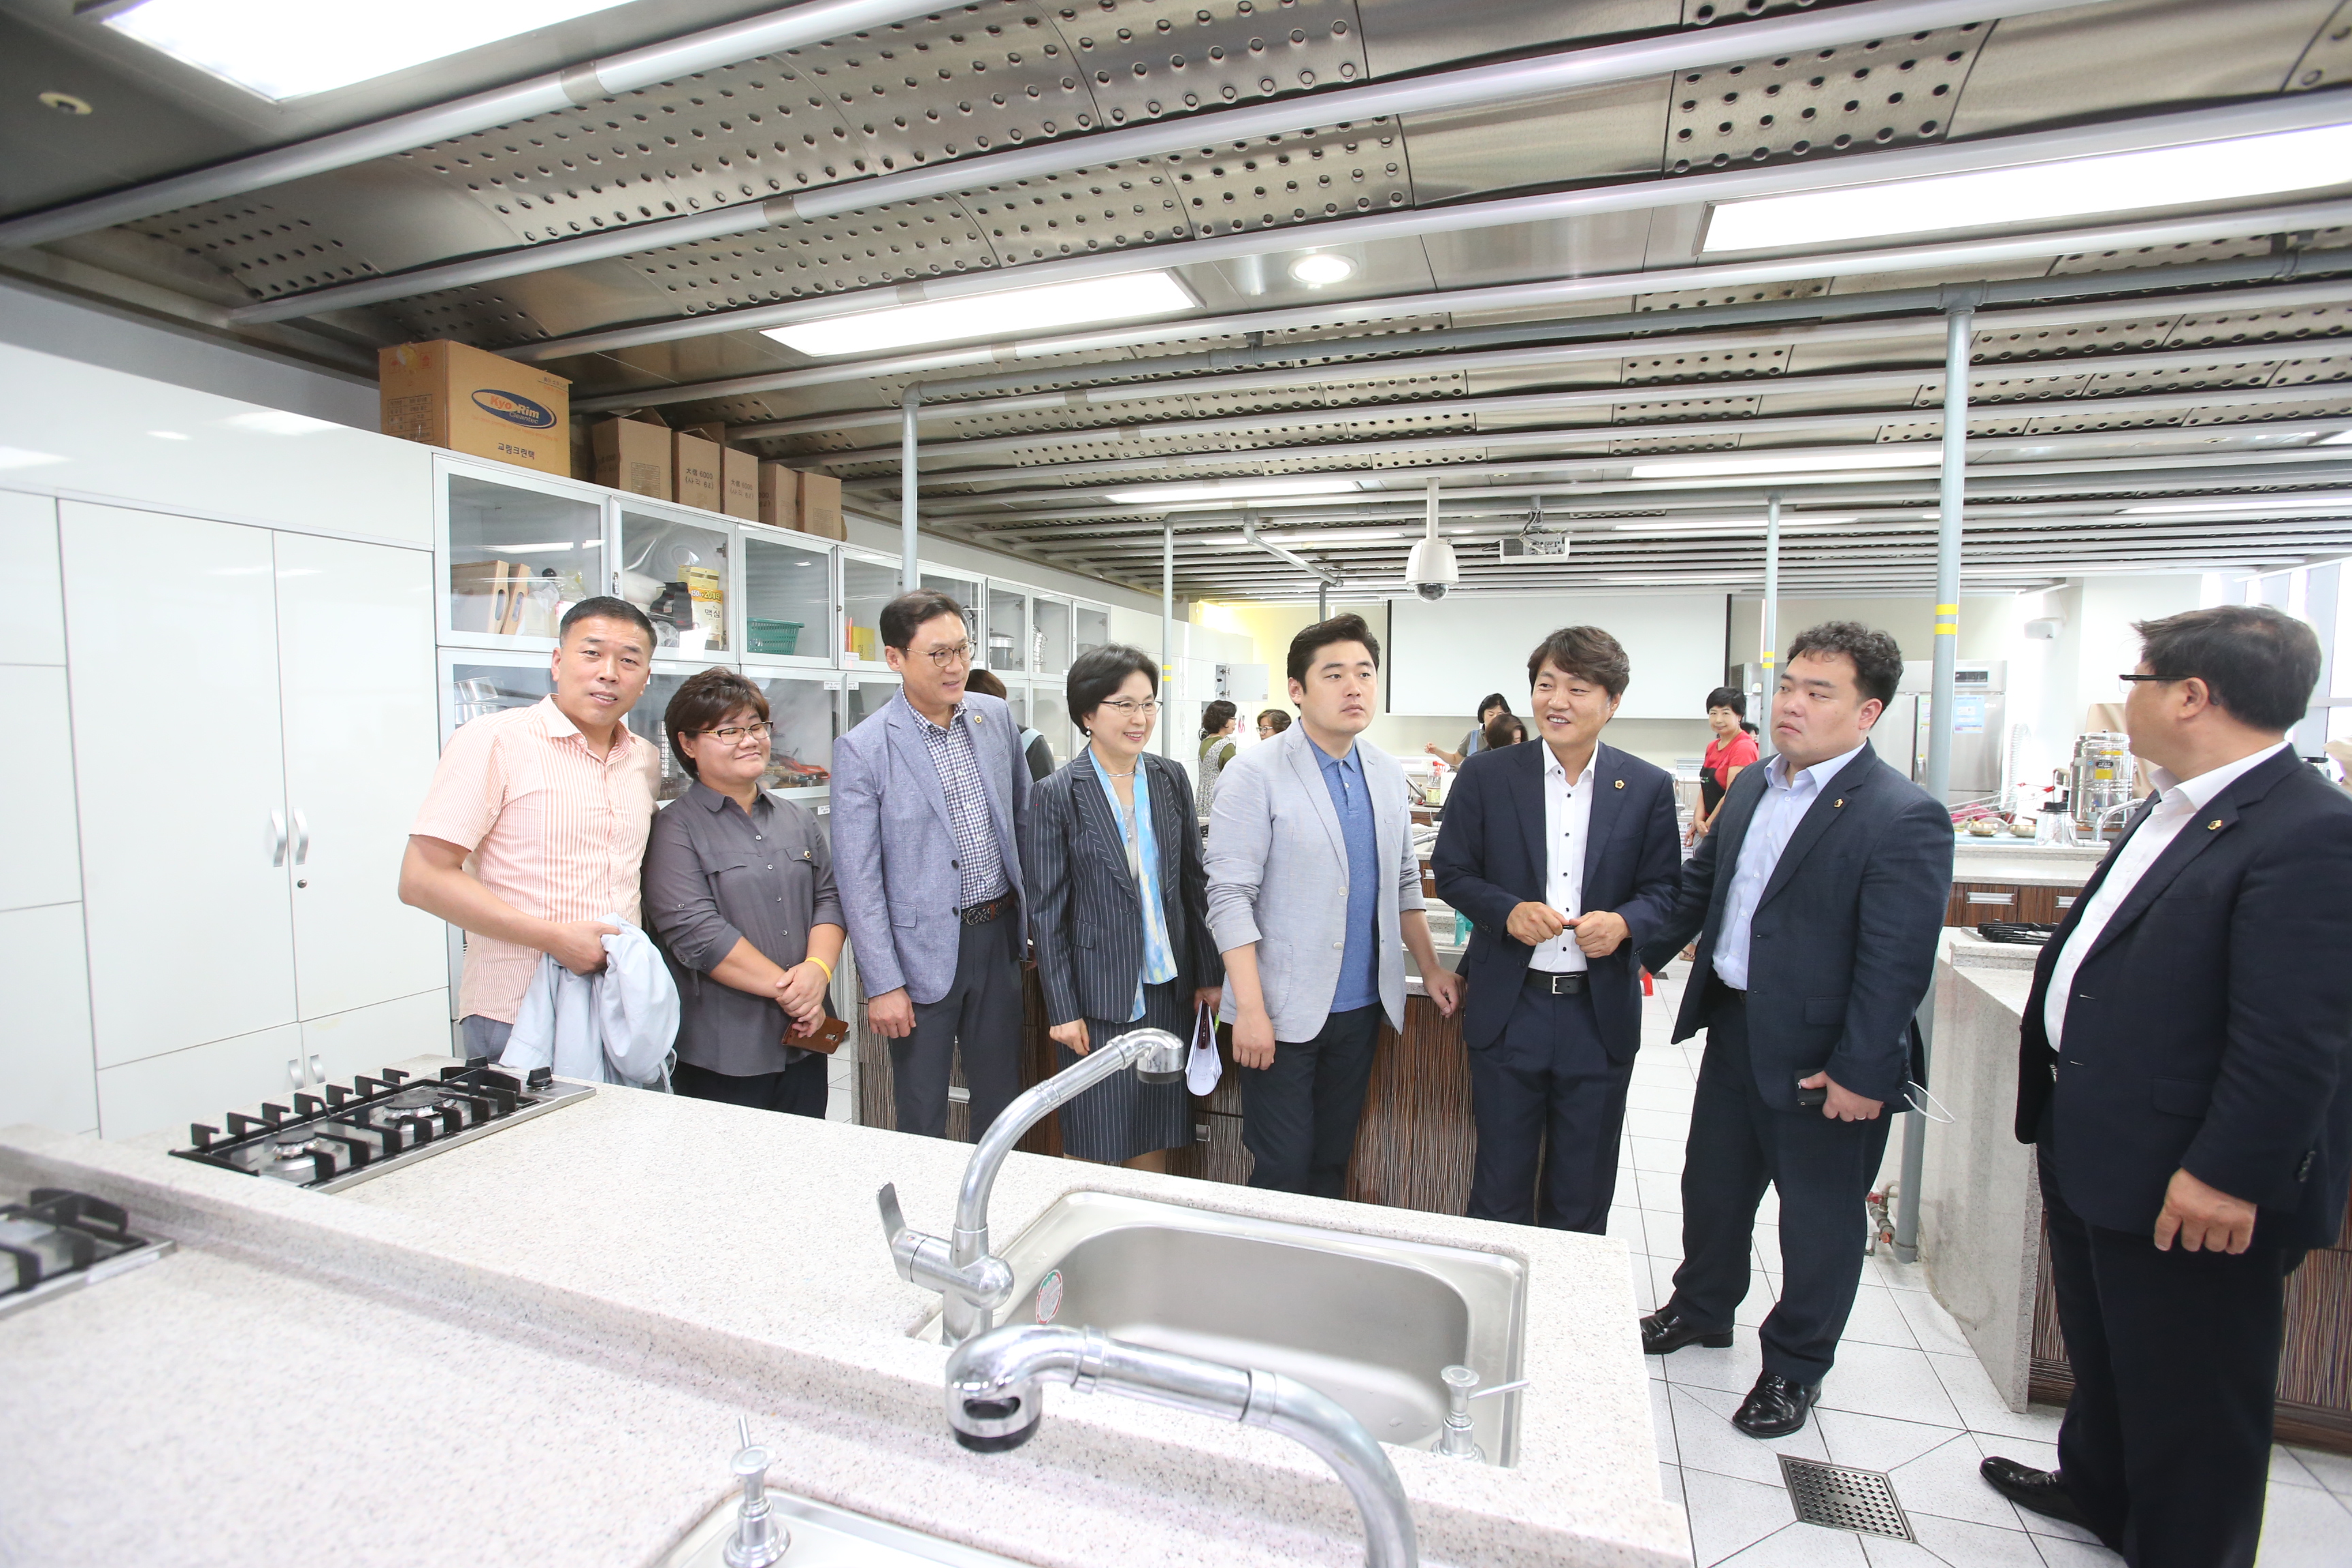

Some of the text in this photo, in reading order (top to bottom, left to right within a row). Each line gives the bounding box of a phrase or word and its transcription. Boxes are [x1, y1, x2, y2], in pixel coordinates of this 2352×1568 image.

[509, 412, 538, 424] Cleantec
[497, 442, 535, 459] 교림크린텍
[700, 470, 713, 480] 6000
[704, 609, 720, 618] 맥심
